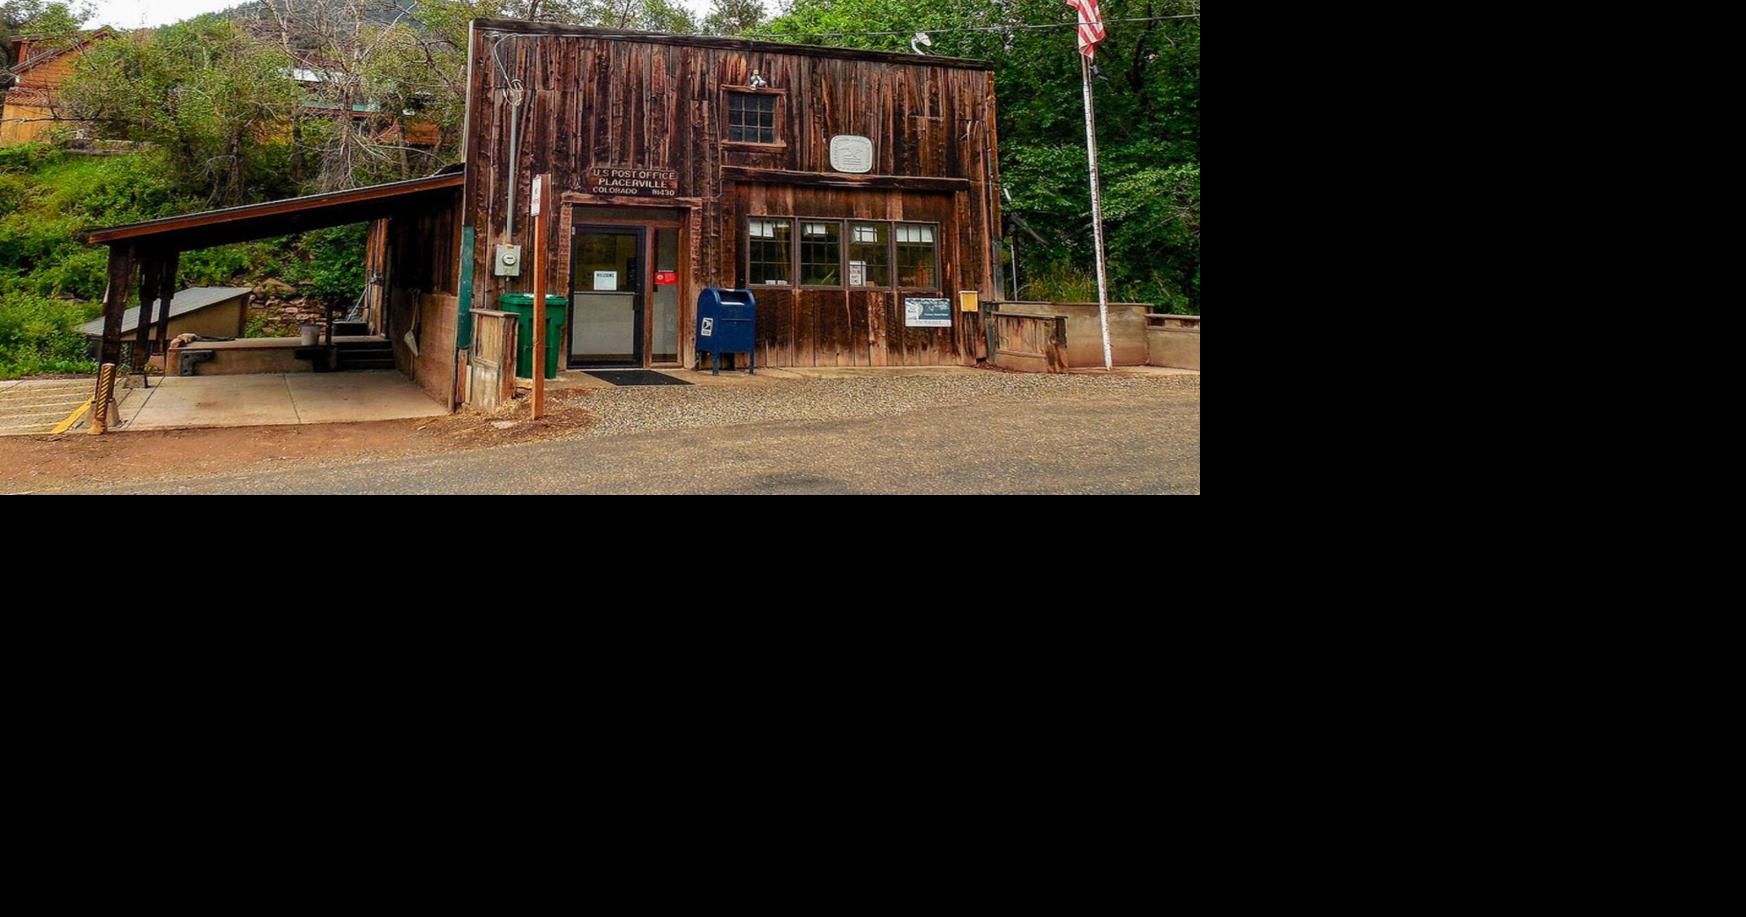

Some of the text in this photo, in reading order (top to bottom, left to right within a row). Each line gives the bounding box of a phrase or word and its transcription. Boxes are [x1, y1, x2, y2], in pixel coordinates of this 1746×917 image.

[611, 169, 637, 178] POST
[638, 171, 676, 180] OFFICE
[598, 178, 667, 188] PLACERVILLE
[592, 186, 638, 194] COLORADO
